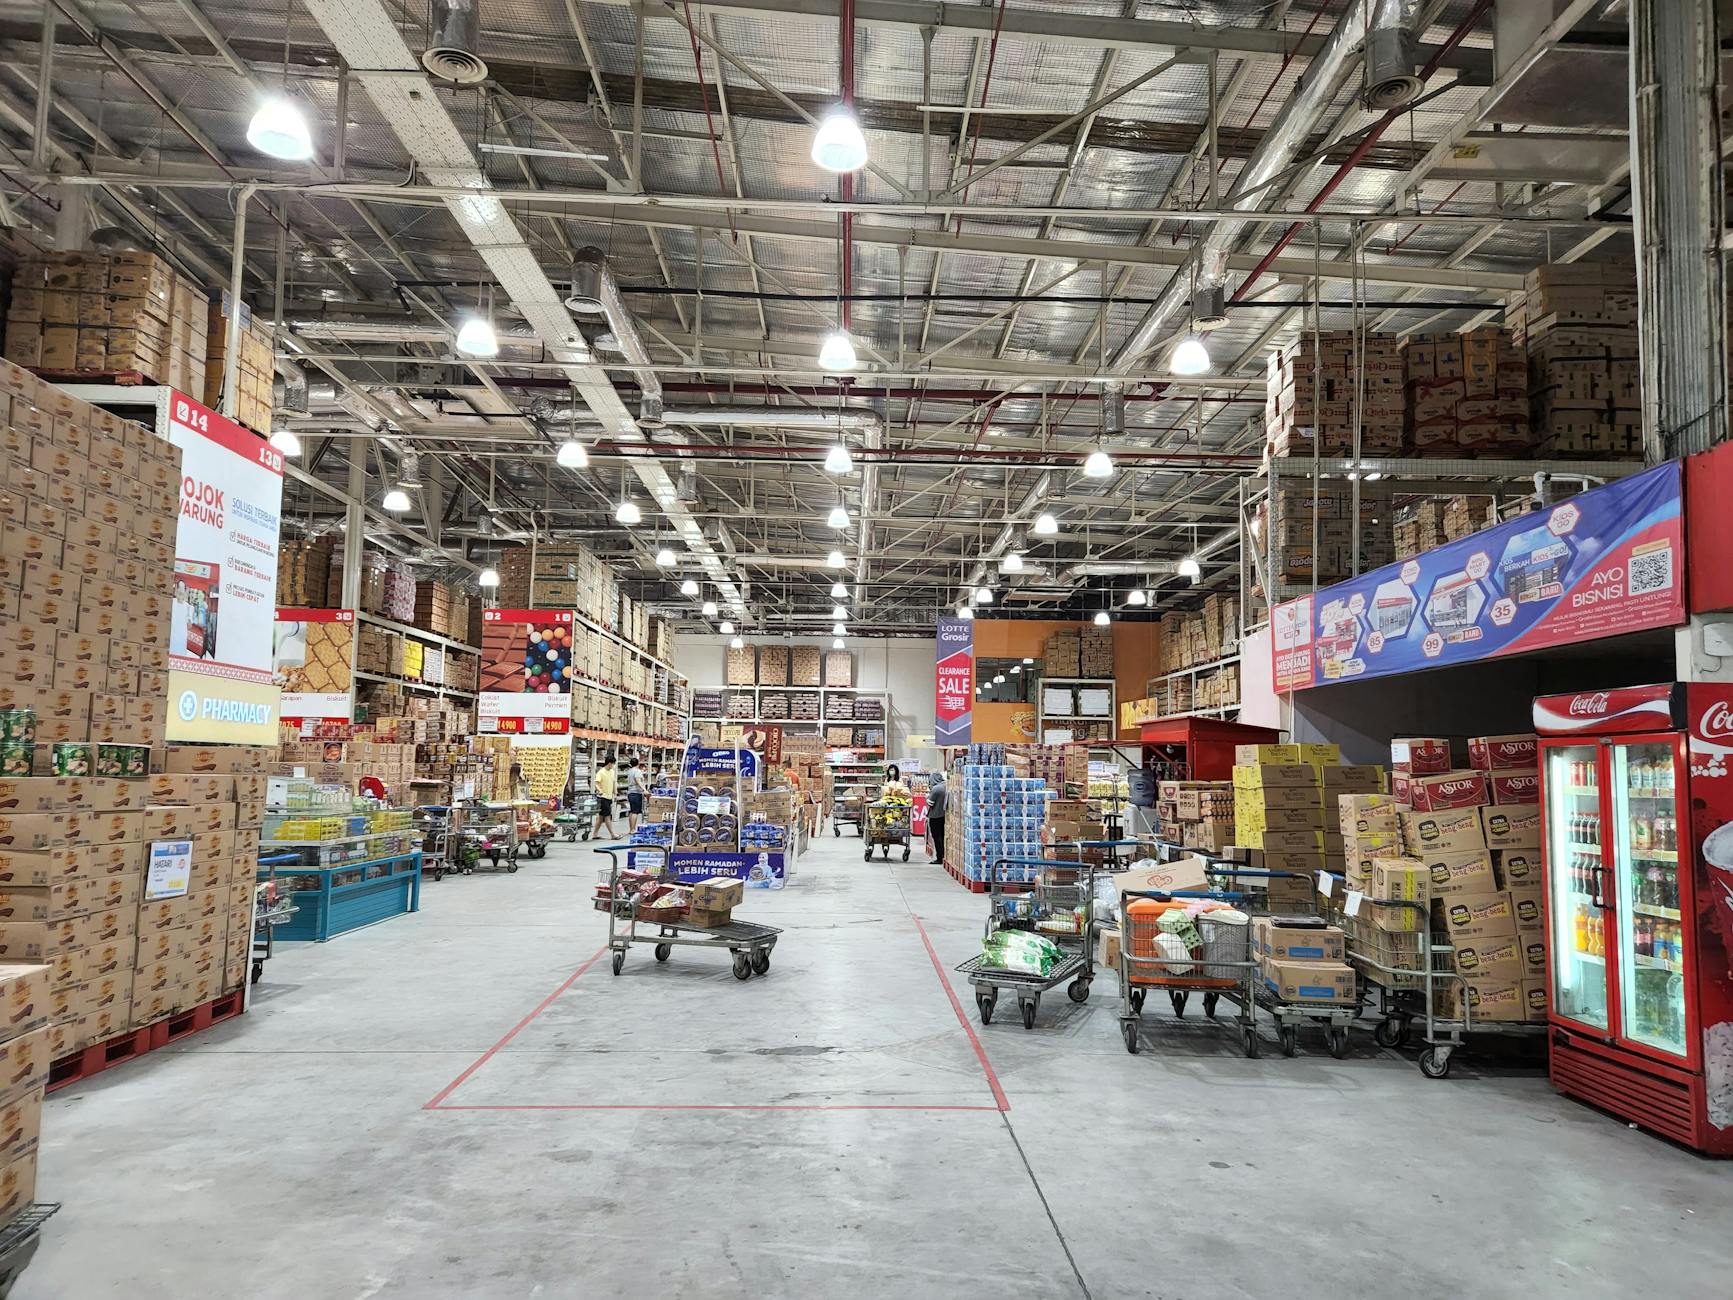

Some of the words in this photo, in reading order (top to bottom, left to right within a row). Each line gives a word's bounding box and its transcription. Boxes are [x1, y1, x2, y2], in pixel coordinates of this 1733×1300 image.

[190, 410, 208, 432] 14
[259, 448, 272, 466] 13
[180, 476, 224, 511] OJOK
[1553, 510, 1574, 522] KIOS
[1556, 519, 1570, 528] GO
[1504, 559, 1530, 572] BERKAH
[1591, 567, 1624, 587] AYO
[1572, 584, 1623, 608] BISNIS!
[335, 612, 342, 620] 3
[494, 612, 502, 620] 2
[555, 613, 561, 621] 1
[1495, 604, 1511, 618] 35
[941, 633, 970, 642] Grosir
[1369, 637, 1381, 647] 85
[1425, 640, 1439, 651] 99
[938, 667, 970, 675] CLEARANCE
[201, 697, 271, 725] PHARMACY
[498, 720, 517, 730] 14900
[544, 721, 562, 731] 14900
[1416, 747, 1444, 756] ASOR
[1500, 741, 1536, 755] ASTOR
[1438, 779, 1474, 794] ASTOR
[1441, 820, 1475, 834] beng-beng
[674, 859, 704, 867] MOMEN
[704, 860, 742, 868] RAMADAN
[1451, 863, 1486, 877] beng-beng
[678, 866, 709, 875] LEBIH
[710, 868, 738, 876] SERU
[1472, 906, 1506, 920] beng-beng
[1480, 950, 1514, 963] beng-beng
[1481, 993, 1516, 1003] beng-beng
